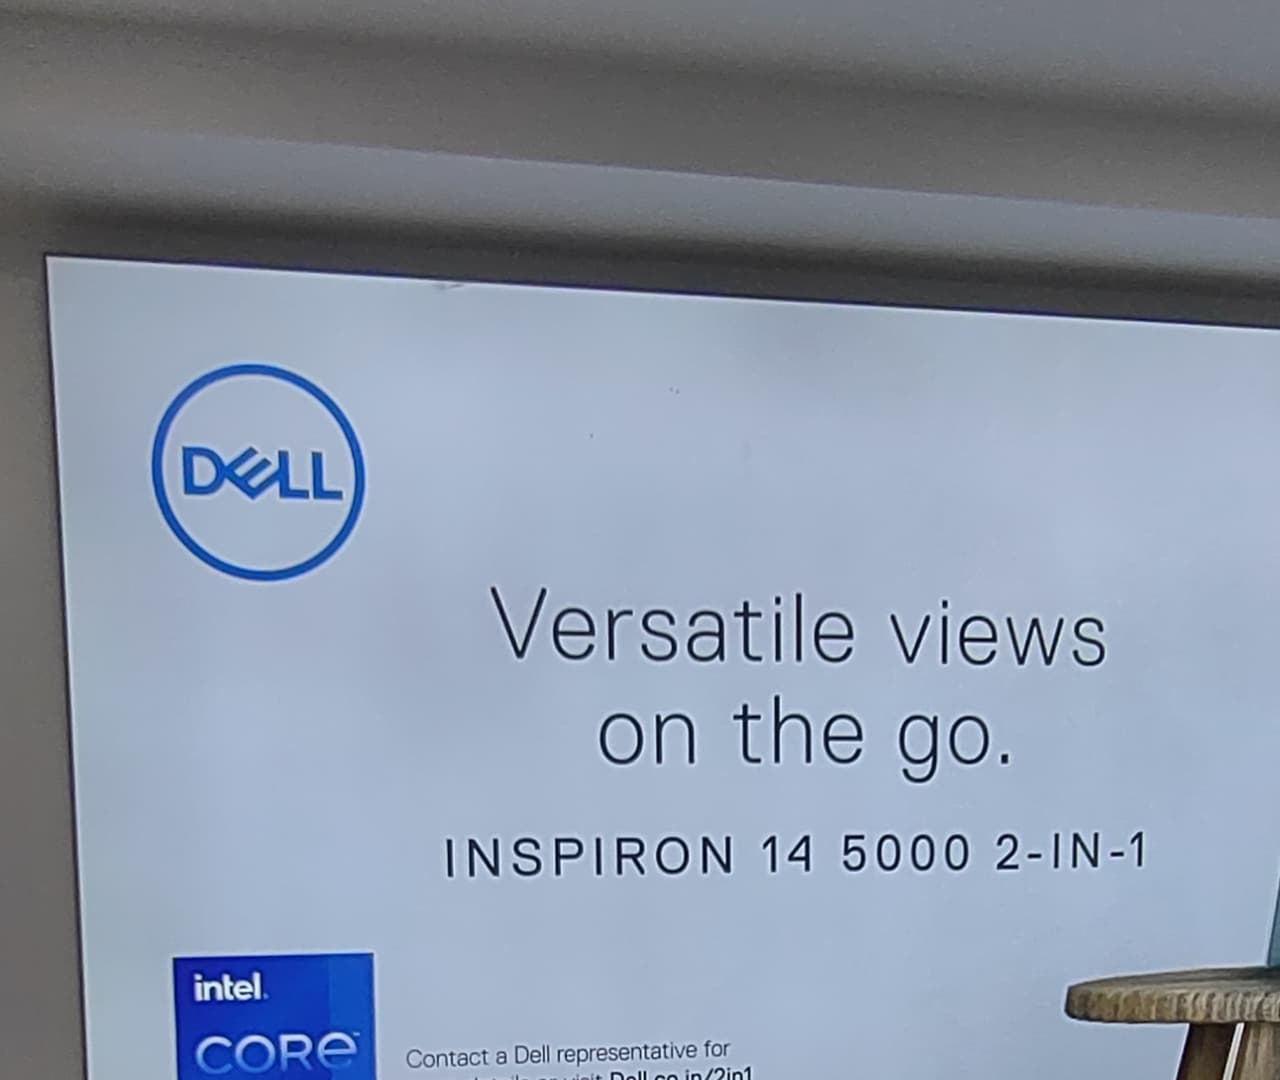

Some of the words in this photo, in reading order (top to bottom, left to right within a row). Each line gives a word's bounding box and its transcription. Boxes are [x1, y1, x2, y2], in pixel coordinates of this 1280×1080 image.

[182, 446, 343, 500] DELL
[490, 586, 855, 663] Versatile
[889, 600, 1108, 666] views
[598, 711, 696, 765] on
[733, 695, 865, 765] the
[898, 712, 1012, 783] go.
[445, 836, 733, 877] INSPIRON
[762, 834, 813, 873] 14
[841, 832, 971, 872] 5000
[995, 830, 1146, 871] 2-IN-1
[406, 1048, 489, 1069] Contact
[496, 1051, 508, 1064] a
[515, 1045, 550, 1065] Dell
[557, 1041, 698, 1067] representative
[704, 1040, 731, 1057] for
